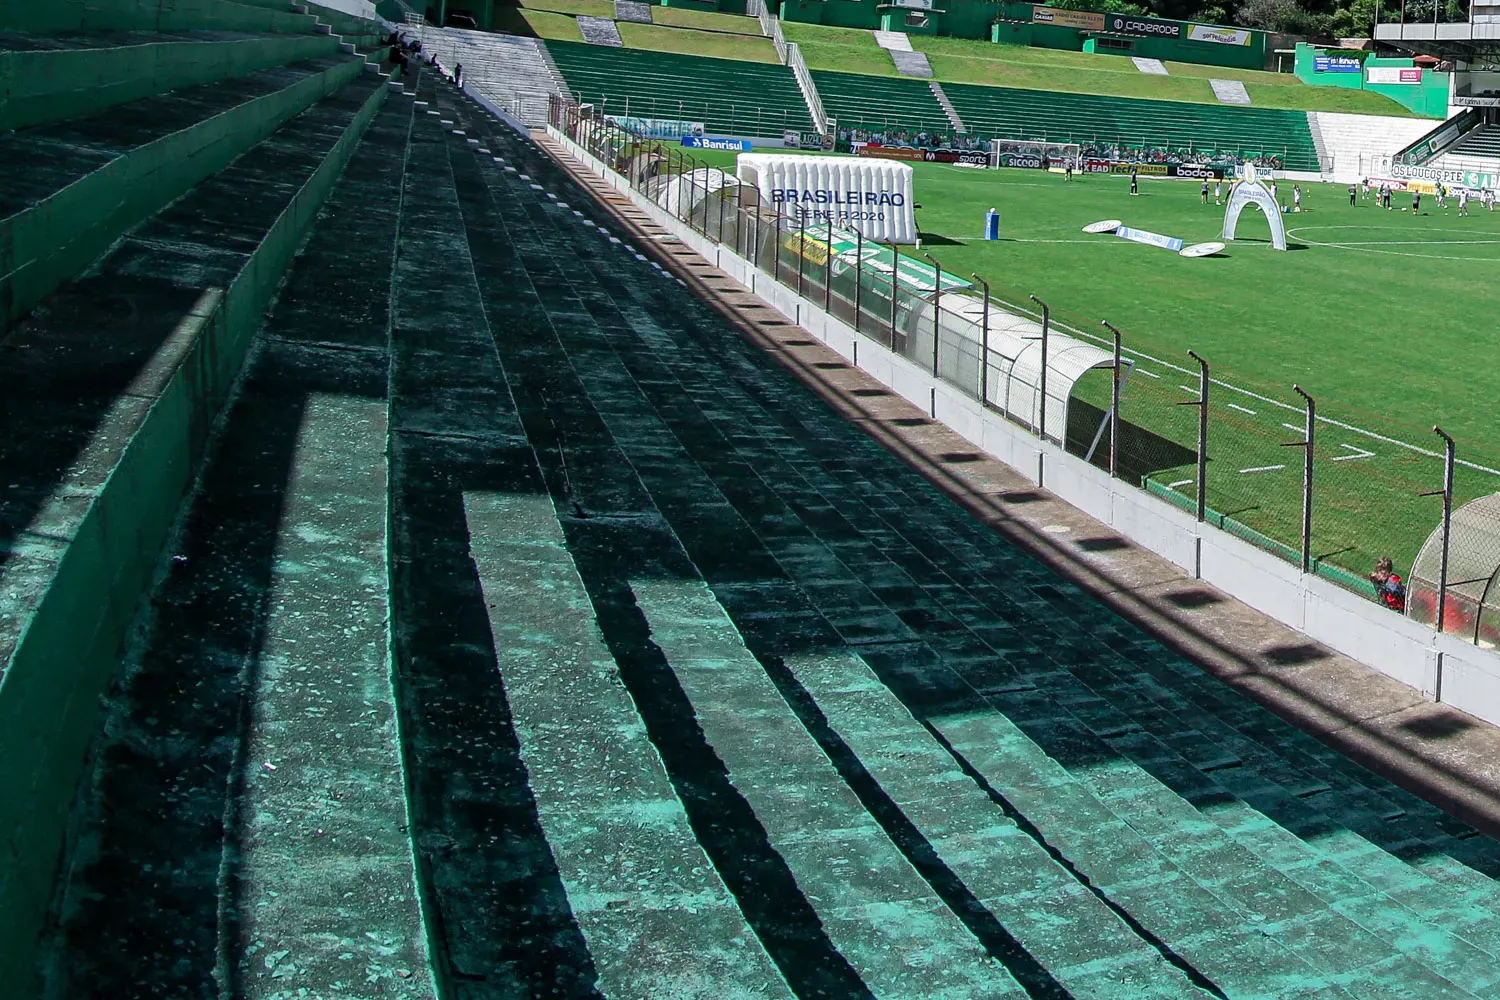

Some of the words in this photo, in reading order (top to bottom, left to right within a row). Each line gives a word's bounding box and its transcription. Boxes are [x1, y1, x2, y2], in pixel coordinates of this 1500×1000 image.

[702, 138, 743, 151] Banrisul
[1009, 158, 1040, 168] SICOOB
[1092, 164, 1109, 173] EAD
[1236, 168, 1272, 177] JUTUDE
[1394, 165, 1405, 176] OS
[1406, 167, 1441, 180] LOUCOS
[1443, 170, 1463, 182] PTE
[1481, 174, 1490, 187] A
[771, 188, 905, 207] BRASILEIRÃO
[795, 208, 834, 220] SÉRIE
[838, 210, 849, 221] B
[853, 211, 886, 222] 2020
